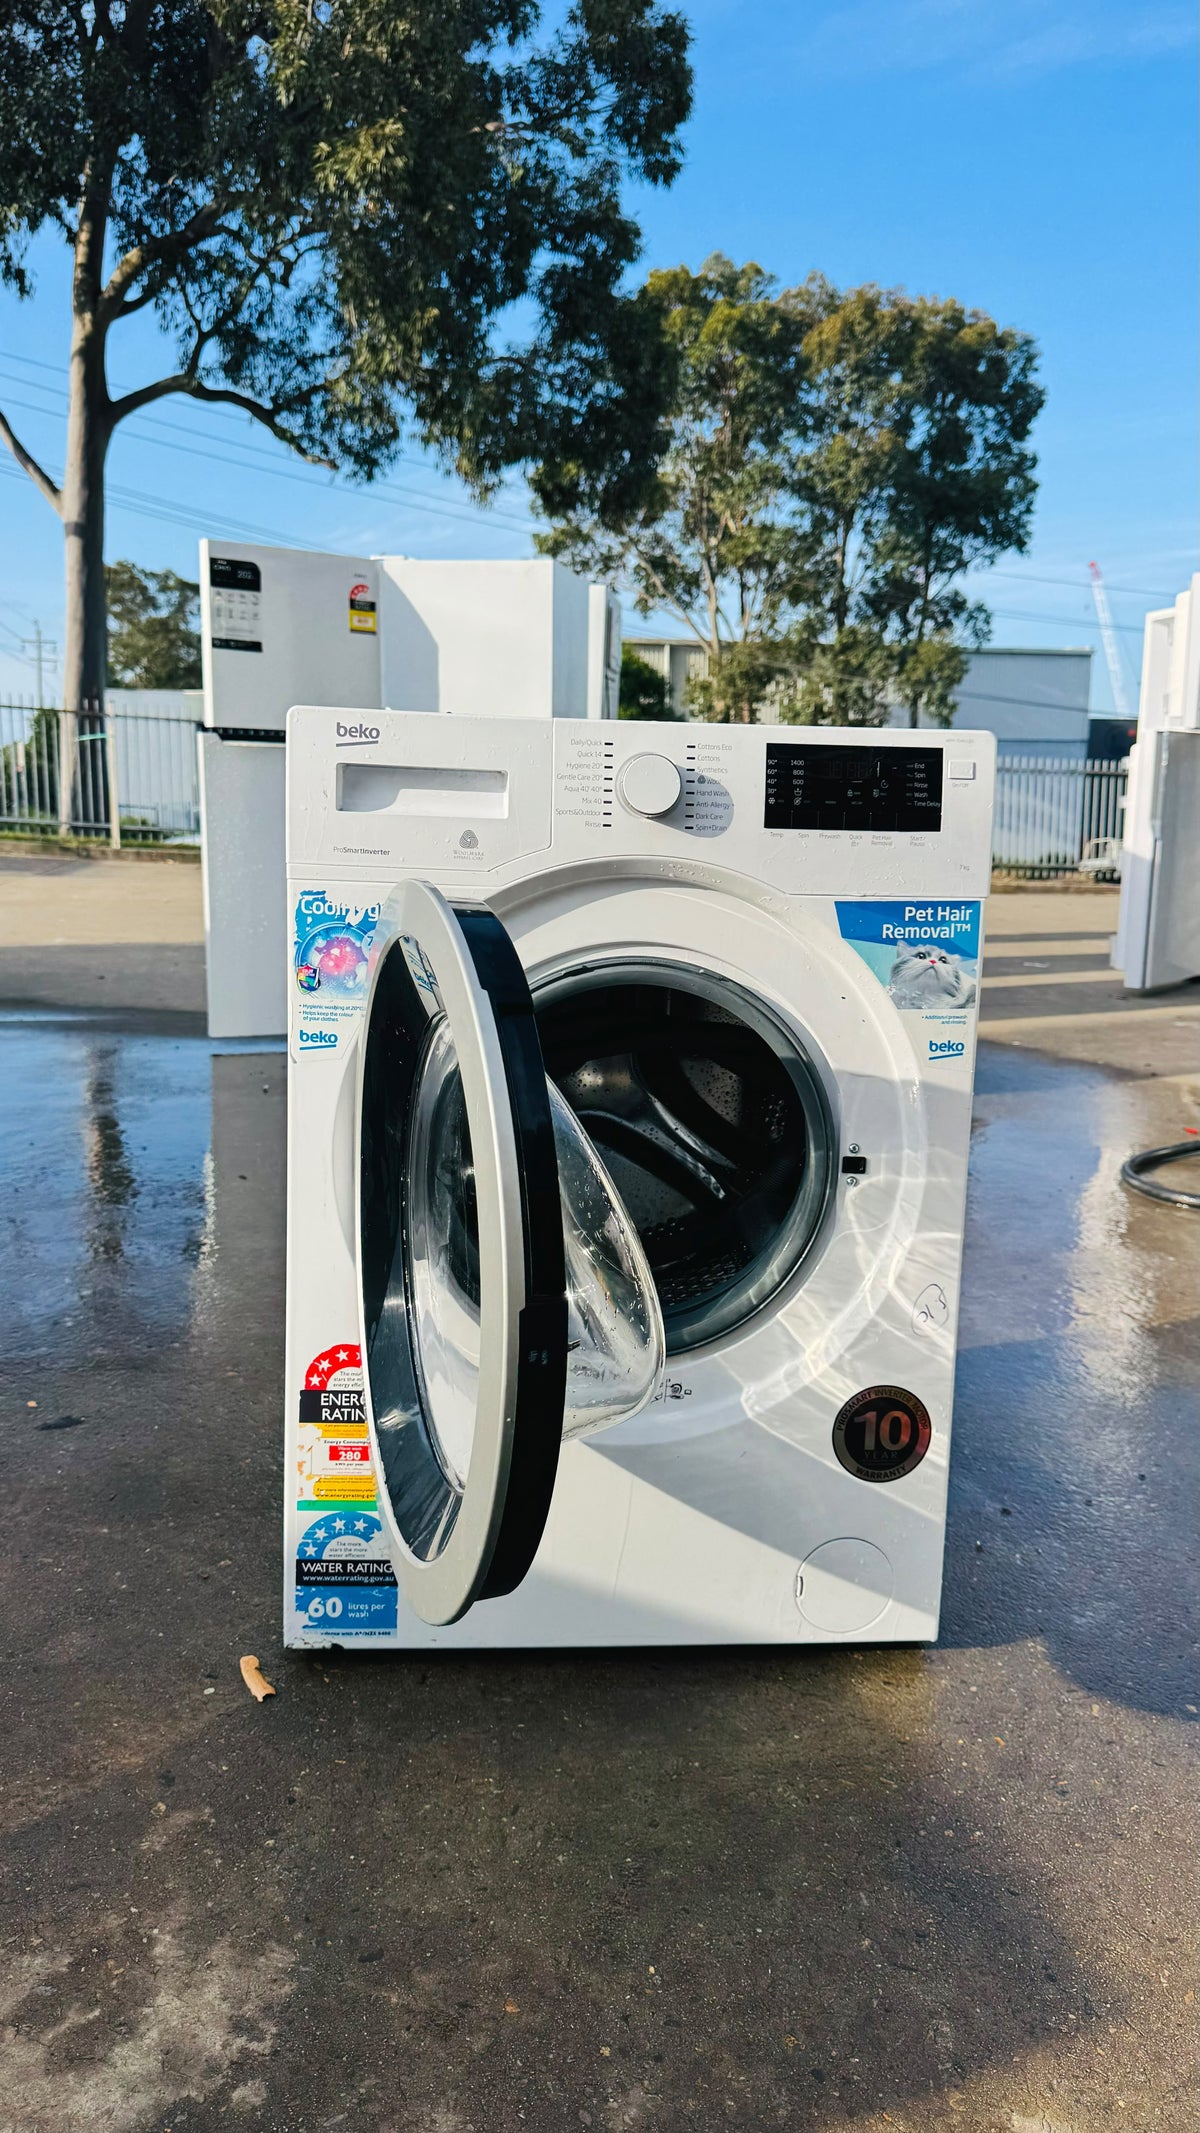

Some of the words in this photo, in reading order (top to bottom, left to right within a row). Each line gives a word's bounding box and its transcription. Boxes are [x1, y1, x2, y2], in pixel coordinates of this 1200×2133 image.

[336, 722, 380, 739] beko
[566, 762, 590, 770] Hygiene
[697, 766, 728, 774] Synthetics
[555, 808, 601, 816] Sports&Outdoor
[585, 820, 602, 828] Rinse
[333, 845, 391, 856] ProSmartInverter
[904, 907, 934, 922] Pet
[937, 906, 973, 921] Hair
[299, 1030, 338, 1043] beko
[929, 1040, 965, 1052] beko
[322, 1408, 366, 1421] RATIN
[854, 1411, 911, 1451] 10
[339, 1451, 361, 1461] 280
[855, 1464, 907, 1480] WARRANTY
[302, 1562, 343, 1573] WATER
[347, 1563, 394, 1573] RATING
[303, 1575, 395, 1583] www.waterrating.gov.au
[308, 1597, 343, 1618] 60
[347, 1602, 369, 1610] litres
[371, 1604, 386, 1612] per
